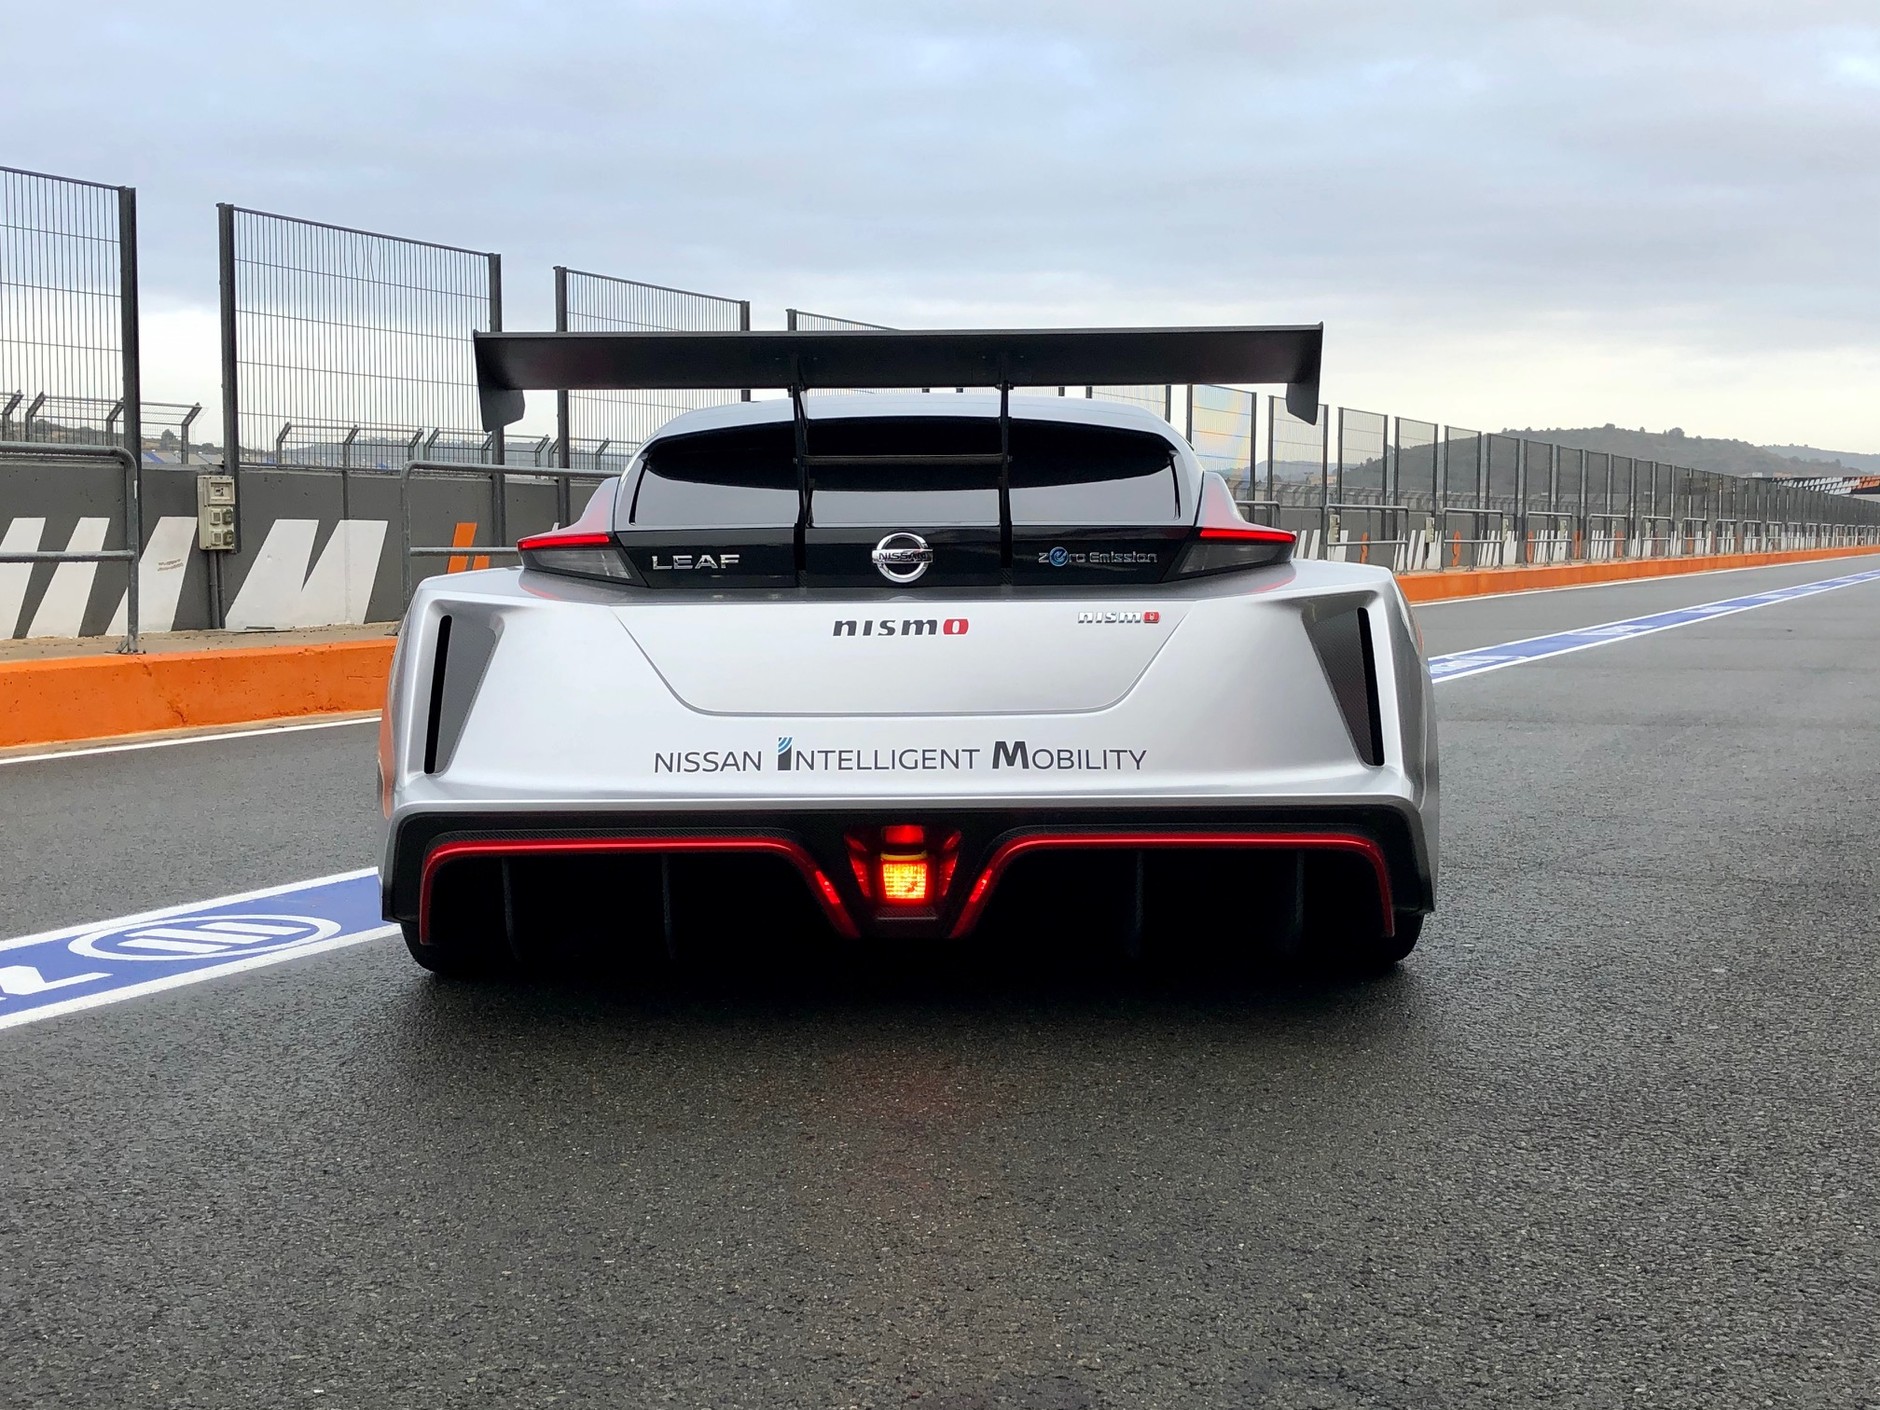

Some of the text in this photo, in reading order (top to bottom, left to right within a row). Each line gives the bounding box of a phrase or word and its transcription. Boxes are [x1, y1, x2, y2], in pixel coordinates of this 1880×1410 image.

[651, 554, 740, 570] LEAF
[878, 552, 928, 561] NISSAN
[1089, 551, 1158, 563] Emission
[1078, 611, 1161, 624] nismo
[833, 618, 969, 636] nismo
[654, 737, 1147, 773] NISSAN INTELLIGENT MOBILITY
